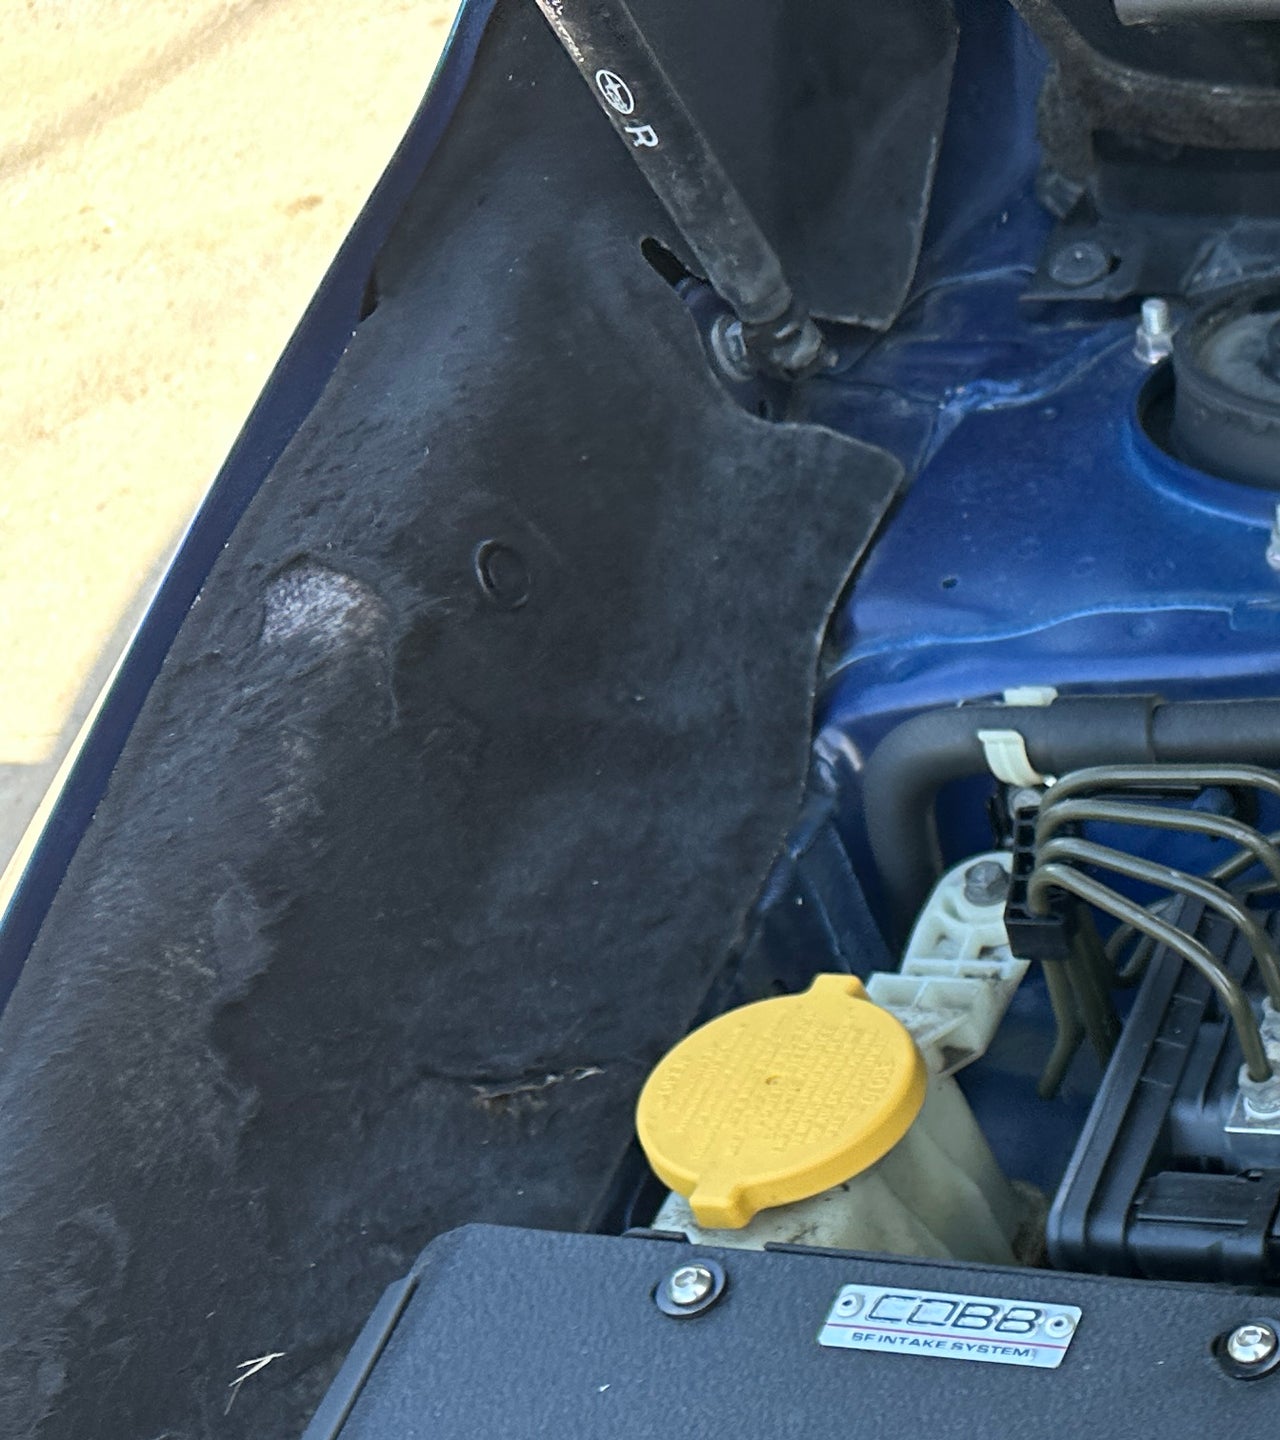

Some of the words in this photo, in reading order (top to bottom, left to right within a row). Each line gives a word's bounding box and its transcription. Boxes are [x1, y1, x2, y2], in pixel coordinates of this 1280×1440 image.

[866, 1294, 1043, 1336] COBB
[852, 1332, 875, 1342] SF
[877, 1335, 948, 1350] INTAKE
[950, 1342, 1030, 1357] SYSTEM
